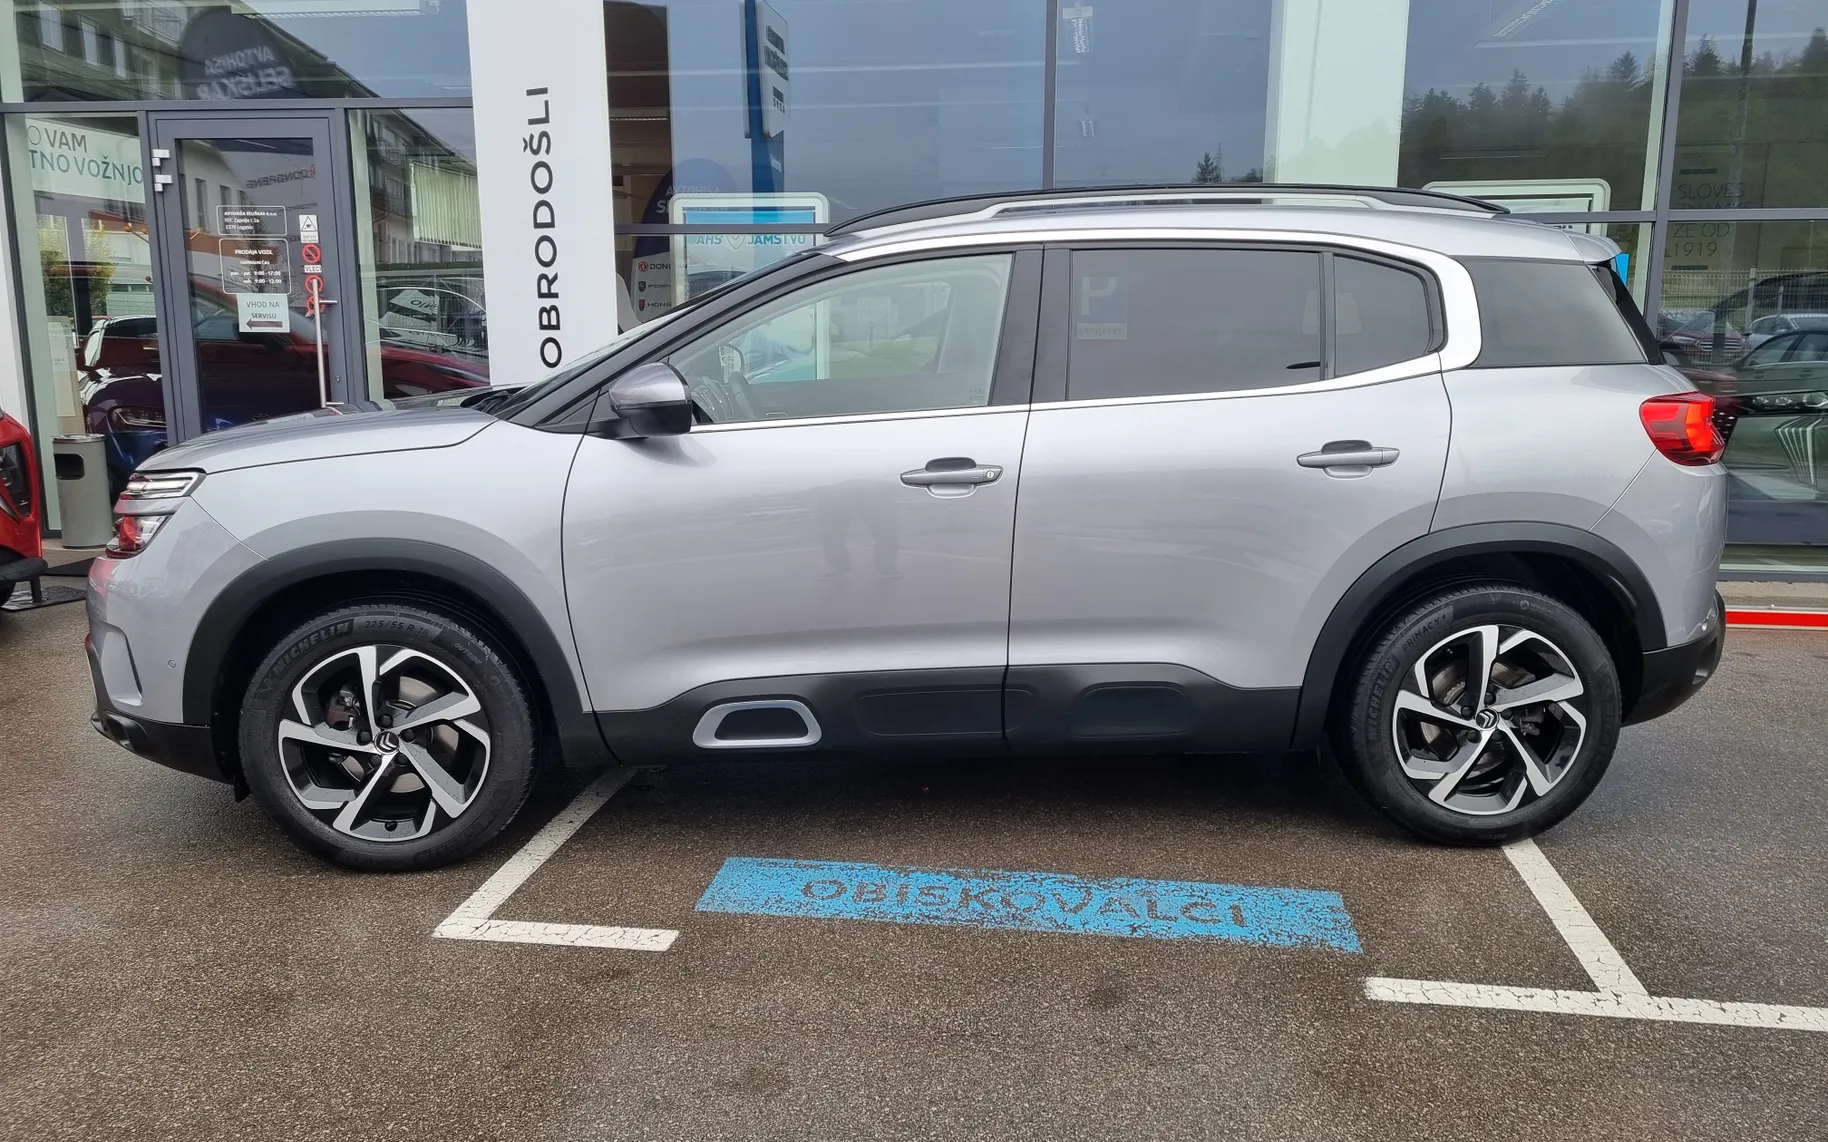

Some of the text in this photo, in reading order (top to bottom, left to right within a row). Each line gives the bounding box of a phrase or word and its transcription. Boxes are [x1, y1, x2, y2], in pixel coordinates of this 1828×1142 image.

[44, 128, 88, 154] VAM
[73, 155, 143, 186] VOŽNJO
[522, 86, 562, 369] OBRODOŠLI
[748, 234, 806, 245] JAMSTVO
[1701, 222, 1730, 238] OD
[1673, 241, 1718, 258] 1919
[364, 620, 405, 630] 225/55
[1402, 617, 1440, 652] PRIMACY
[272, 622, 350, 676] MICHELIN
[801, 879, 1247, 927] OBISKOVALCI
